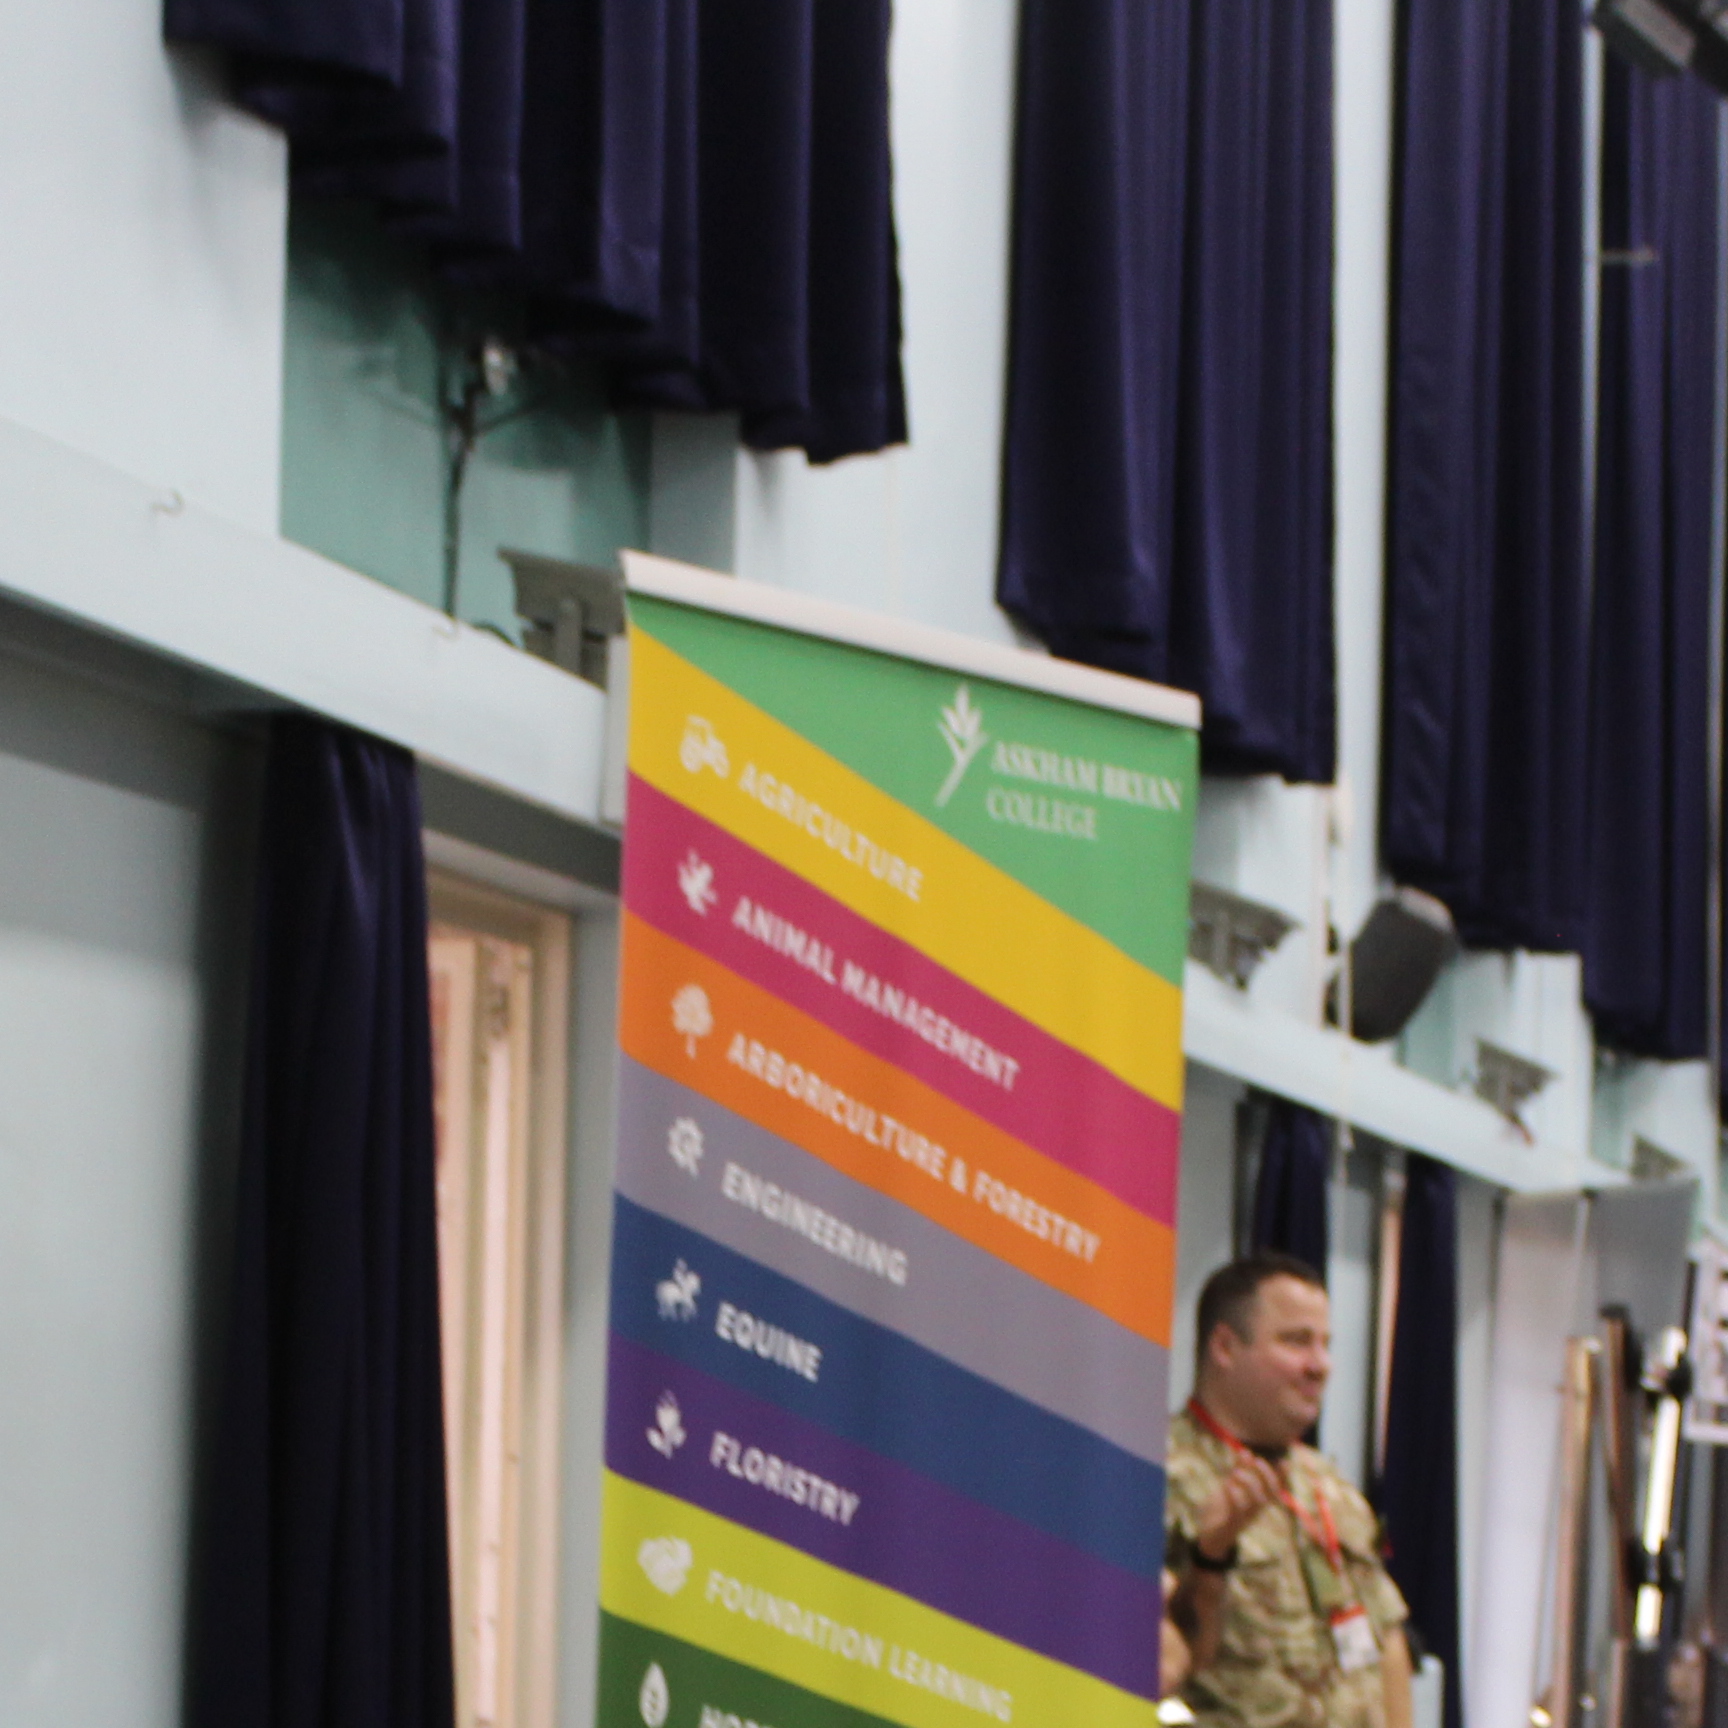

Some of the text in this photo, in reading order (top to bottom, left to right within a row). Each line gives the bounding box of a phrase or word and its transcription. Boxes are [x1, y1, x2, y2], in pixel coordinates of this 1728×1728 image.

[738, 762, 925, 903] AGRICULTURE
[986, 786, 1099, 842] COLLEGE
[991, 740, 1182, 813] ASKHAM BRYAN
[731, 896, 1022, 1093] ANIMAL MANAGEMENT
[727, 1031, 1102, 1264] ARBORICULTURE & FORESTRY
[722, 1162, 909, 1287] ENGINEERING
[714, 1303, 823, 1383] EQUINE
[708, 1430, 861, 1526] FLORISTRY
[704, 1570, 1014, 1724] FOUNDATION LEARNING
